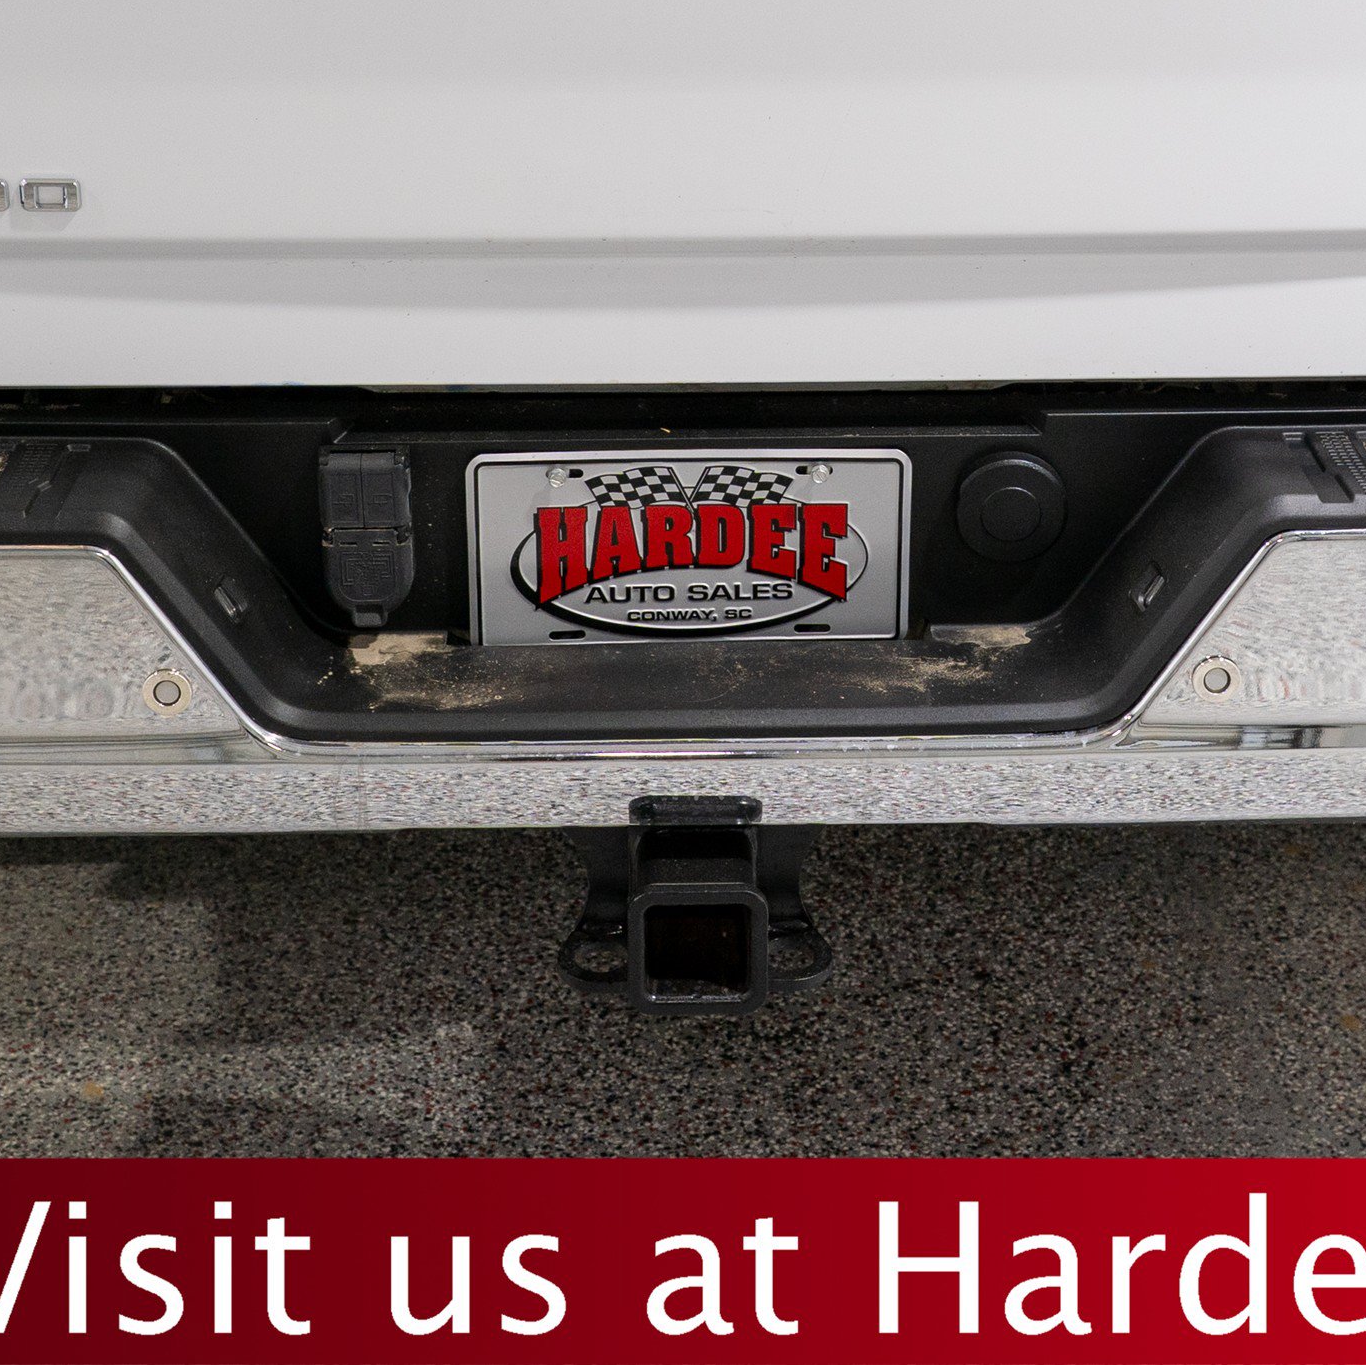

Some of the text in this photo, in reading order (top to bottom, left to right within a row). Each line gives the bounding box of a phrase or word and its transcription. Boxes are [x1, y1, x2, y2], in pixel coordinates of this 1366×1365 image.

[534, 502, 850, 610] HARDEE
[585, 581, 794, 604] AUTO SALES
[627, 608, 752, 622] CONWAY, SC
